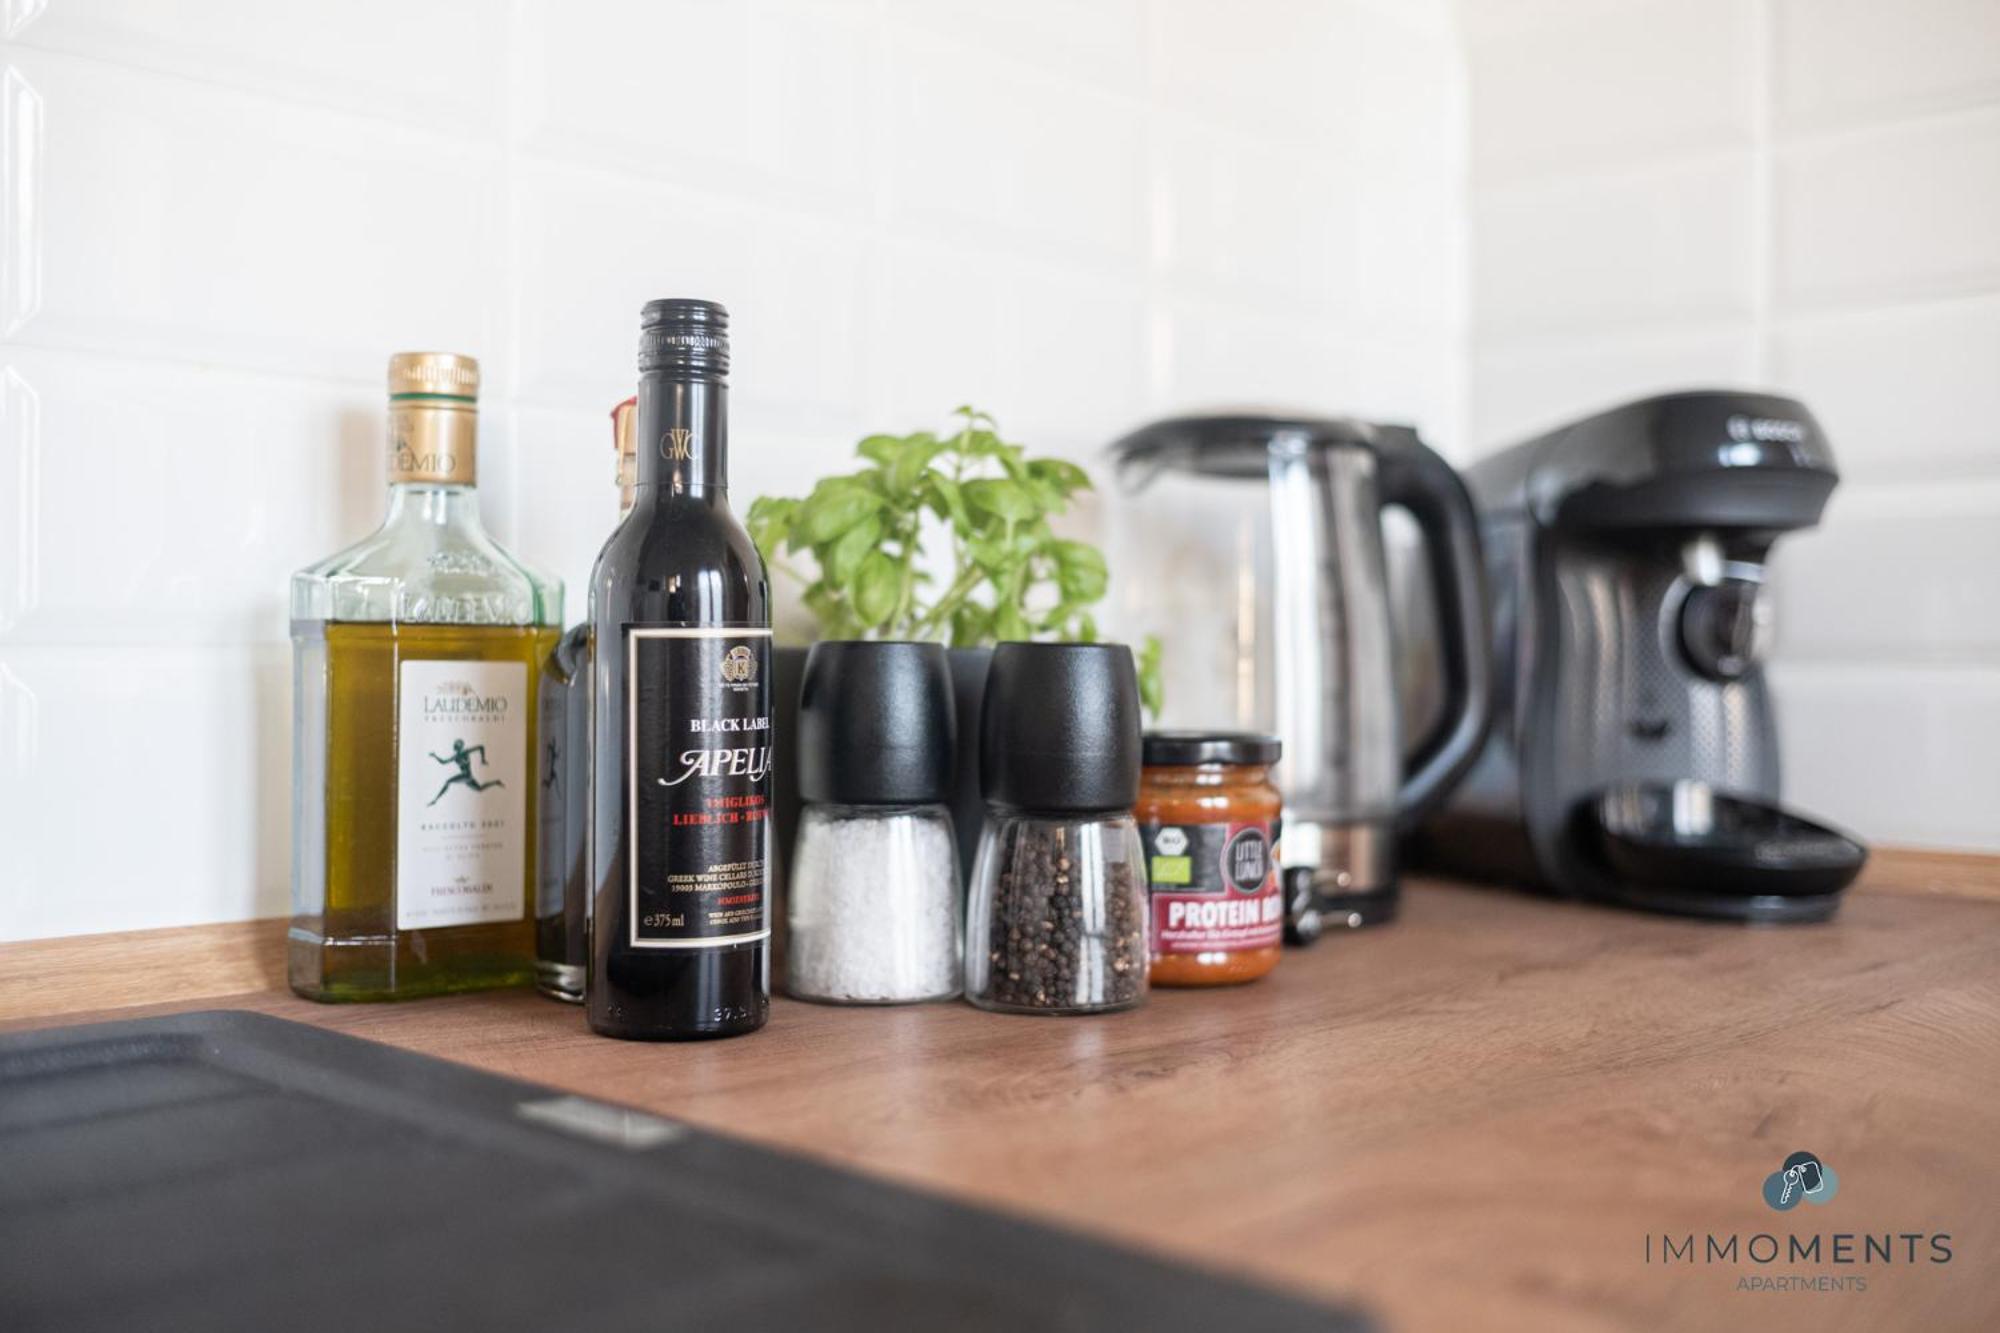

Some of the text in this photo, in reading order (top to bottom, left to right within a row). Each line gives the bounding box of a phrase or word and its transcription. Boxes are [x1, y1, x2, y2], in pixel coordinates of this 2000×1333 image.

[690, 717, 769, 732] BLACK LABEL
[1168, 897, 1261, 929] PROTEIN
